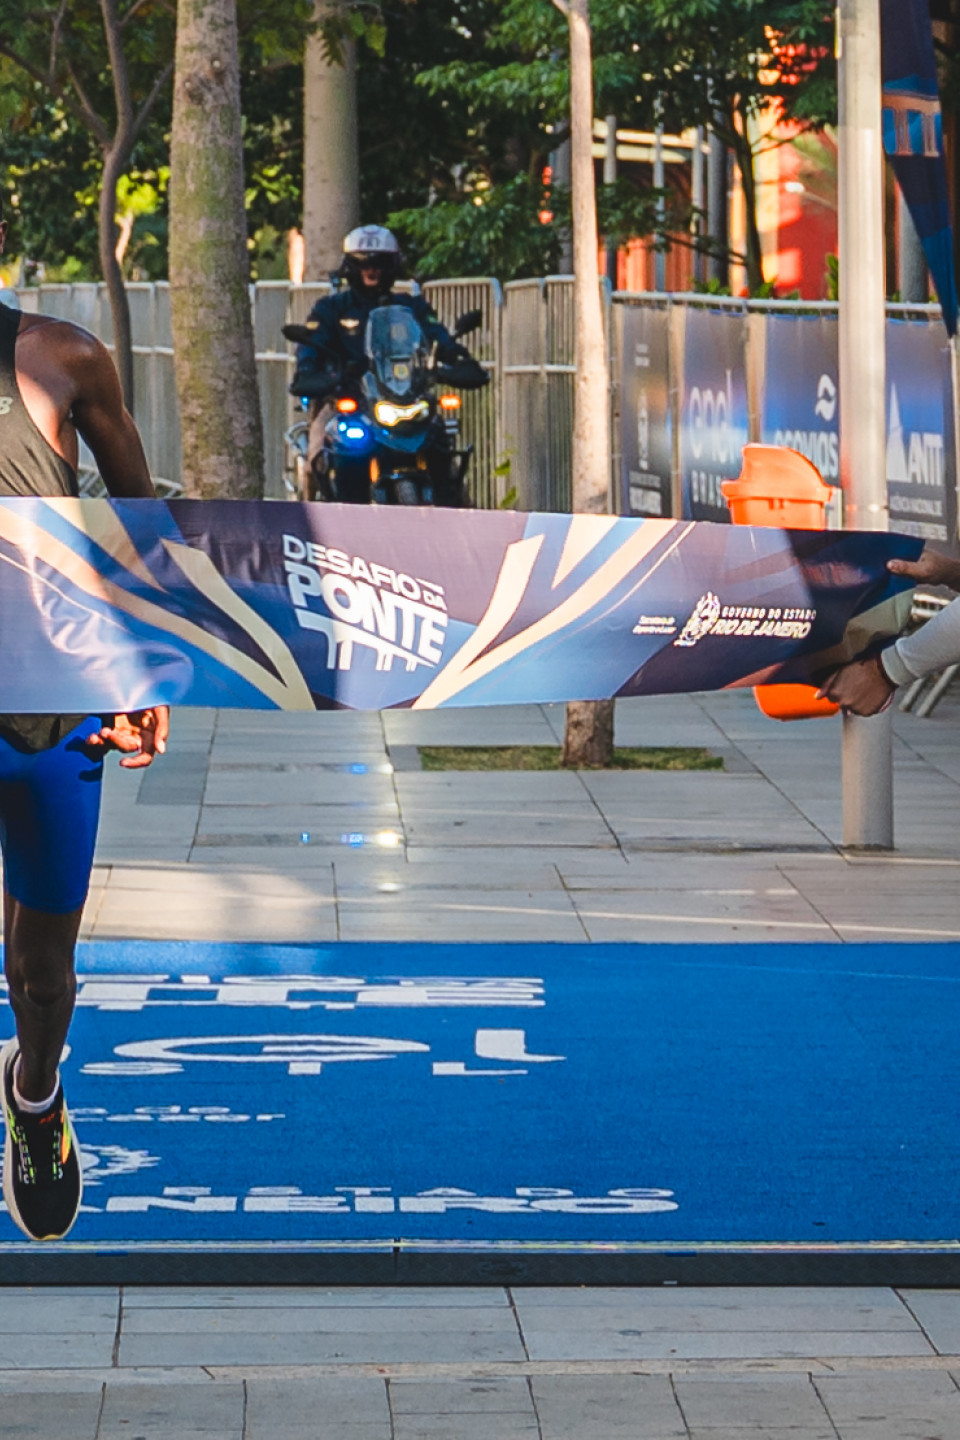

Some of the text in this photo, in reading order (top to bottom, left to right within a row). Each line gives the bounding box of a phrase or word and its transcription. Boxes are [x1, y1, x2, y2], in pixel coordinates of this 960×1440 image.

[282, 534, 423, 600] DESAFIO
[284, 560, 449, 664] PONTE
[710, 619, 735, 636] RIO
[755, 620, 812, 638] JANEIRO
[161, 1185, 675, 1197] ESTADO
